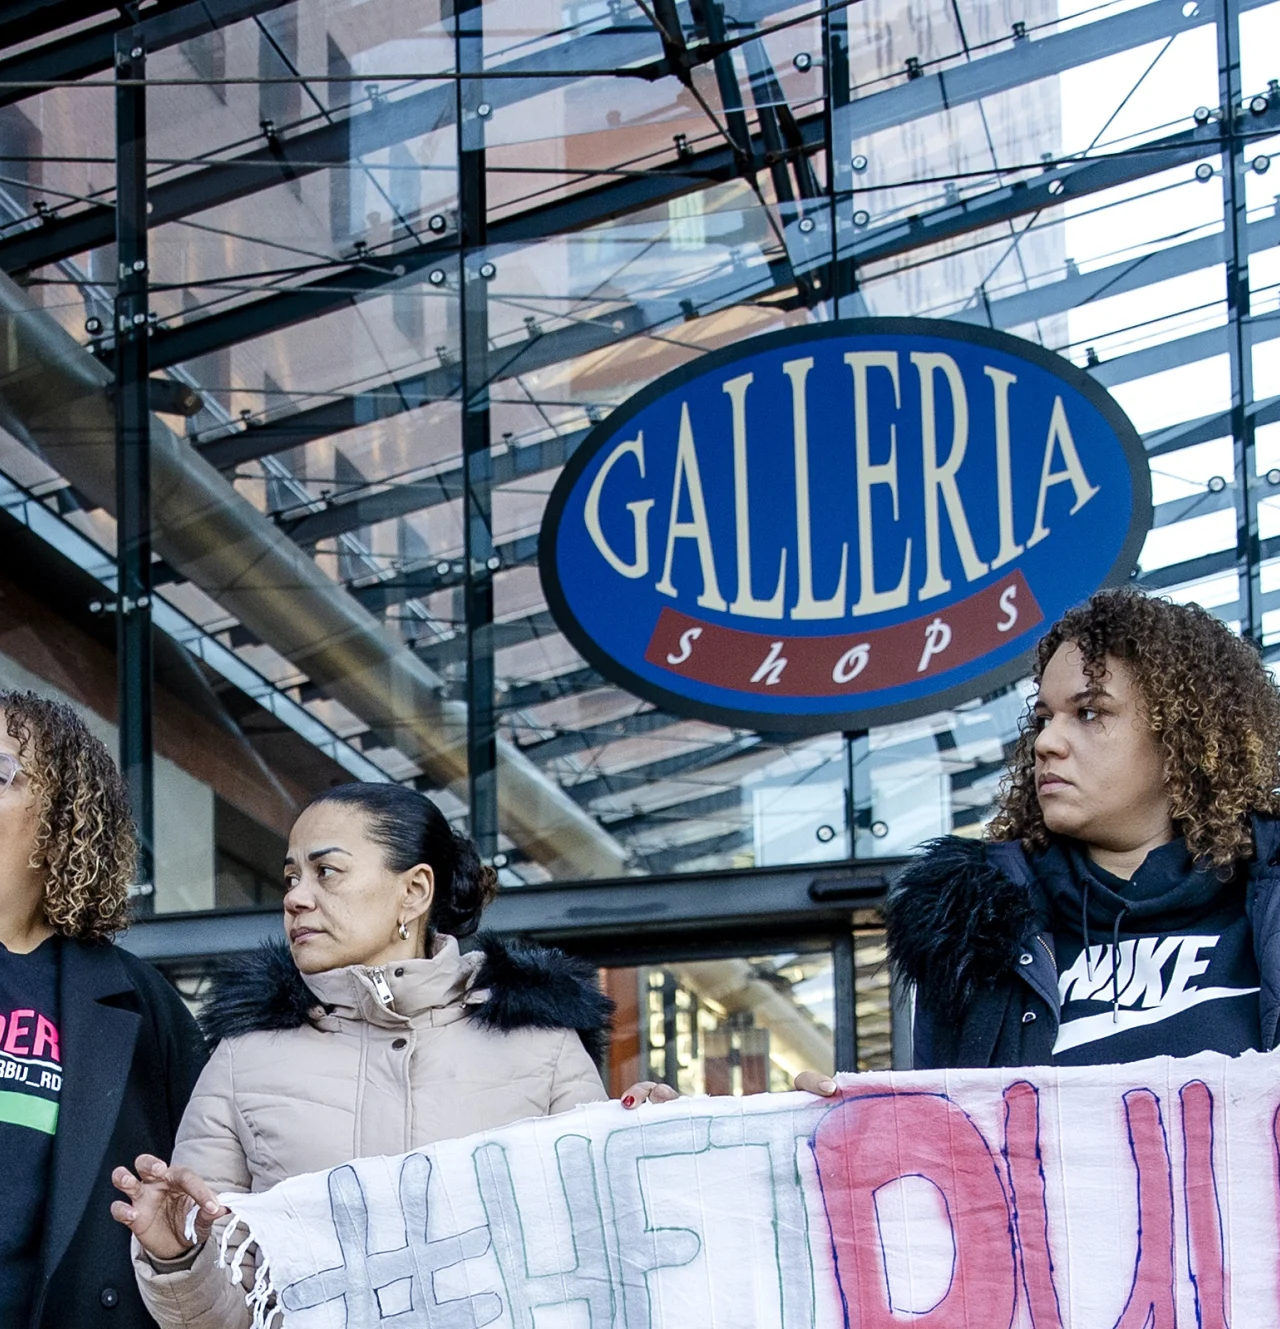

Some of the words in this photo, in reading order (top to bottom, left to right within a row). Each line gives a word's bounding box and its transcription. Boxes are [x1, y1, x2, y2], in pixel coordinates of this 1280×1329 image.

[583, 350, 1101, 621] GALLERIA
[666, 584, 1019, 687] shops
[1058, 935, 1221, 1009] NIKE
